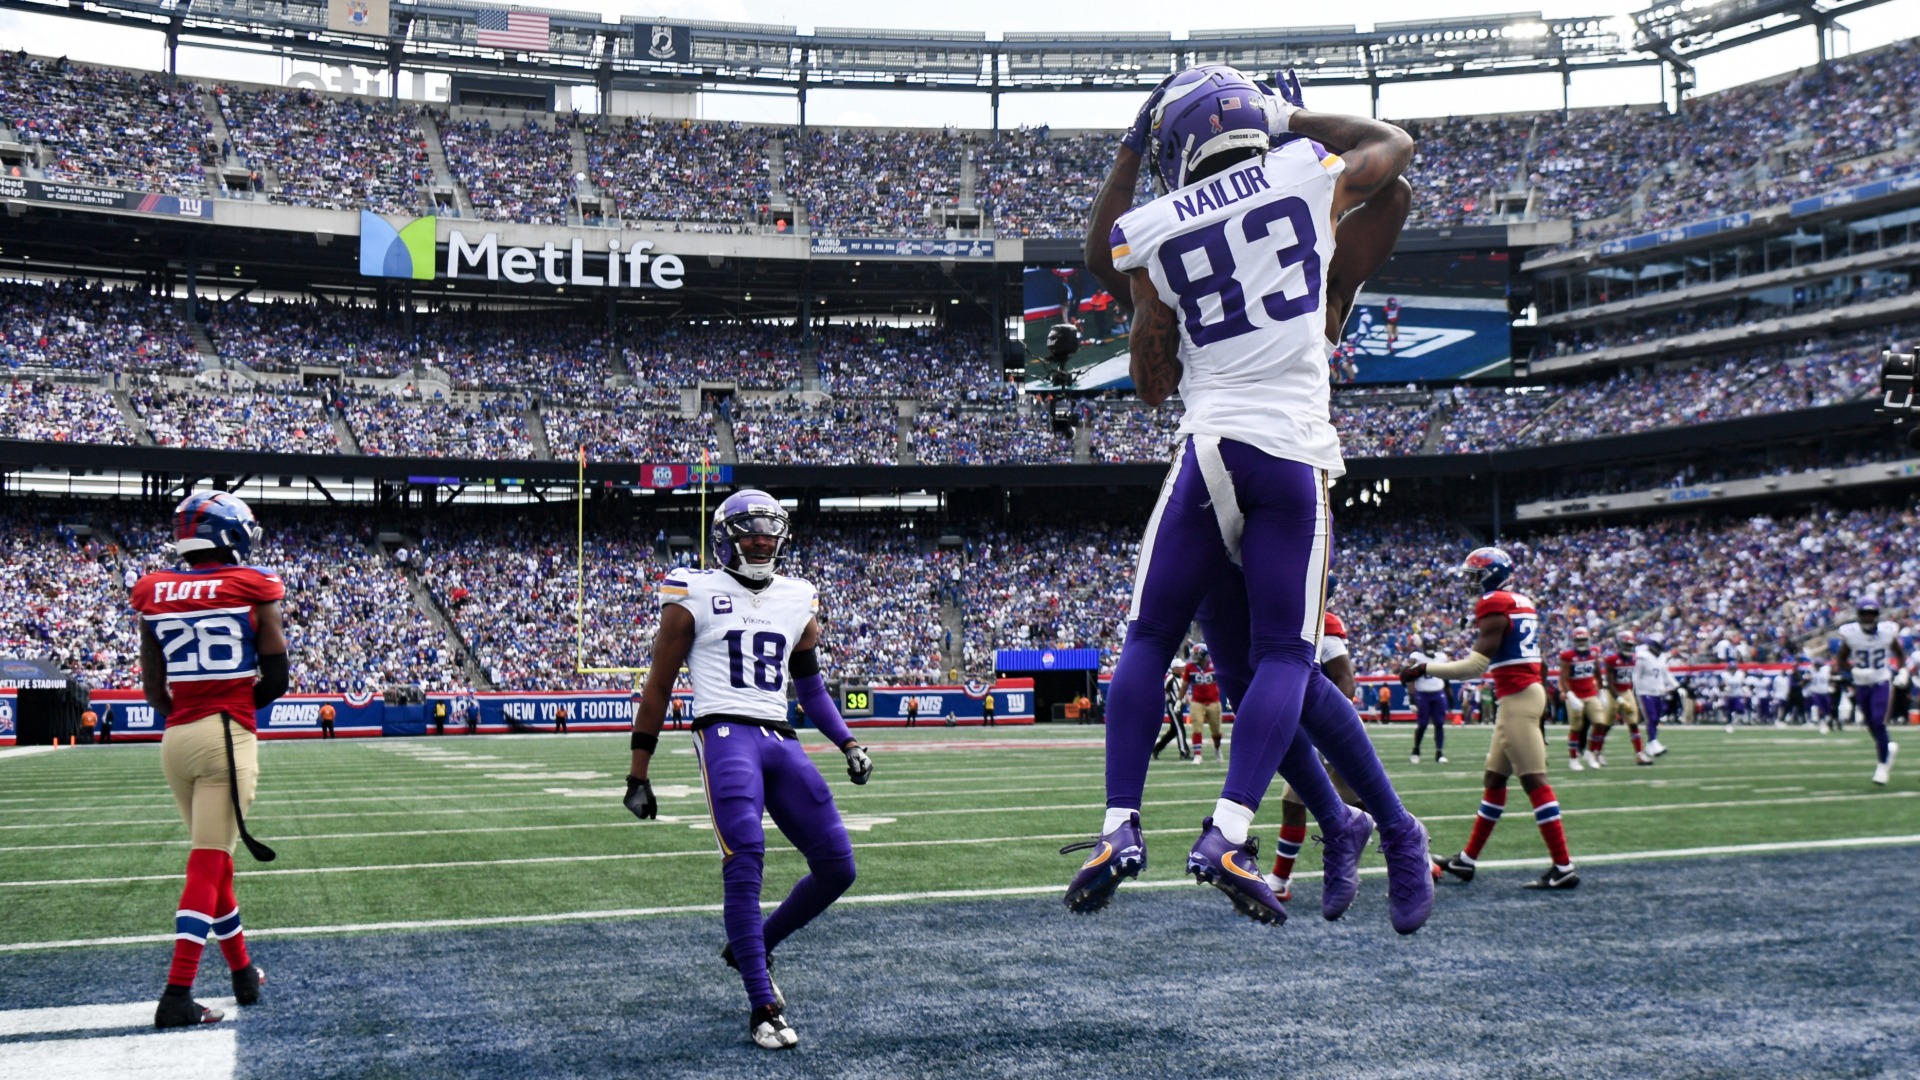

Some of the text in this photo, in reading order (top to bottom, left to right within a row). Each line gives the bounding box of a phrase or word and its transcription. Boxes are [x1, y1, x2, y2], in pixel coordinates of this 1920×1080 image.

[1173, 165, 1271, 222] NAILOR
[447, 231, 685, 290] MetLife
[1158, 196, 1320, 347] 83
[154, 580, 223, 603] FLOTT
[714, 596, 731, 609] C
[155, 617, 243, 672] 28
[722, 630, 786, 692] 18
[1855, 649, 1886, 669] 32
[32, 679, 67, 689] STADIUM
[503, 703, 535, 720] NEW
[581, 701, 632, 720] FOOTBA
[847, 693, 867, 709] 39
[270, 704, 320, 721] GIANTS
